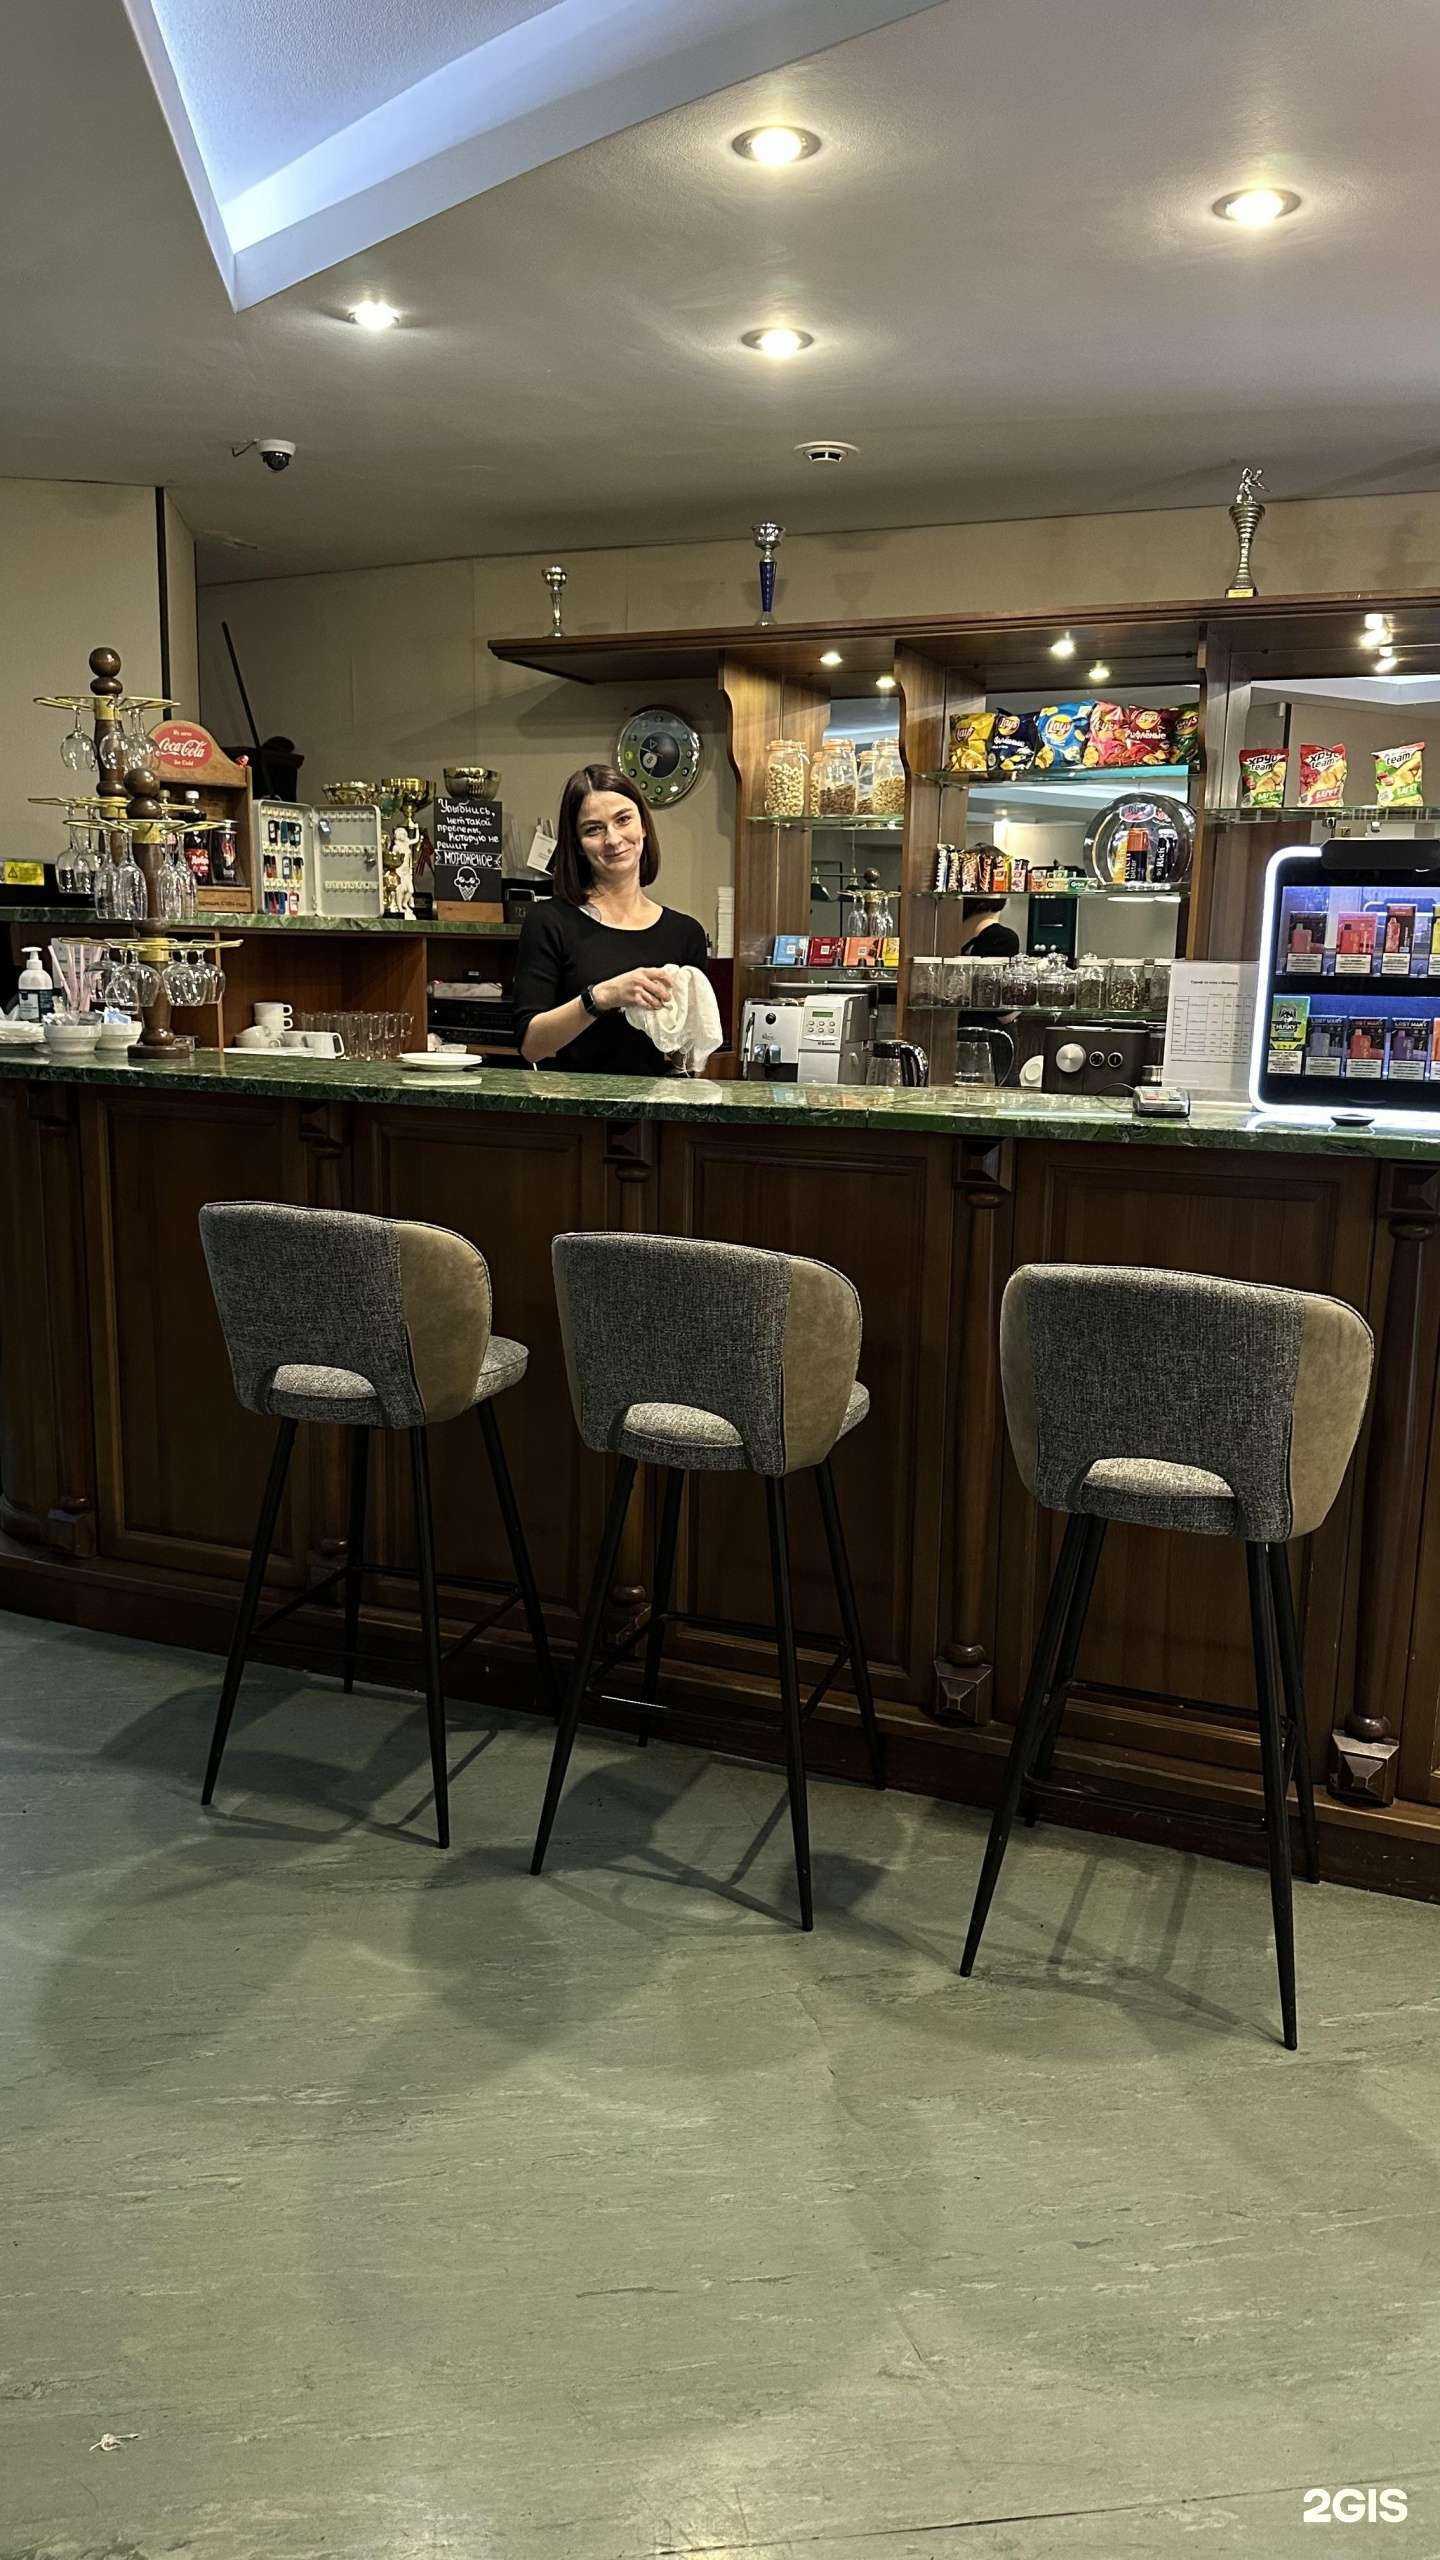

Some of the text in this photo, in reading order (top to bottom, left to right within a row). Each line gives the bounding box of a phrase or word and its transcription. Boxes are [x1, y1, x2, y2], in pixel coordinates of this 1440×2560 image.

[159, 737, 208, 758] Coca-Cola
[1386, 753, 1410, 765] team
[465, 817, 492, 826] такой
[436, 841, 468, 850] решит
